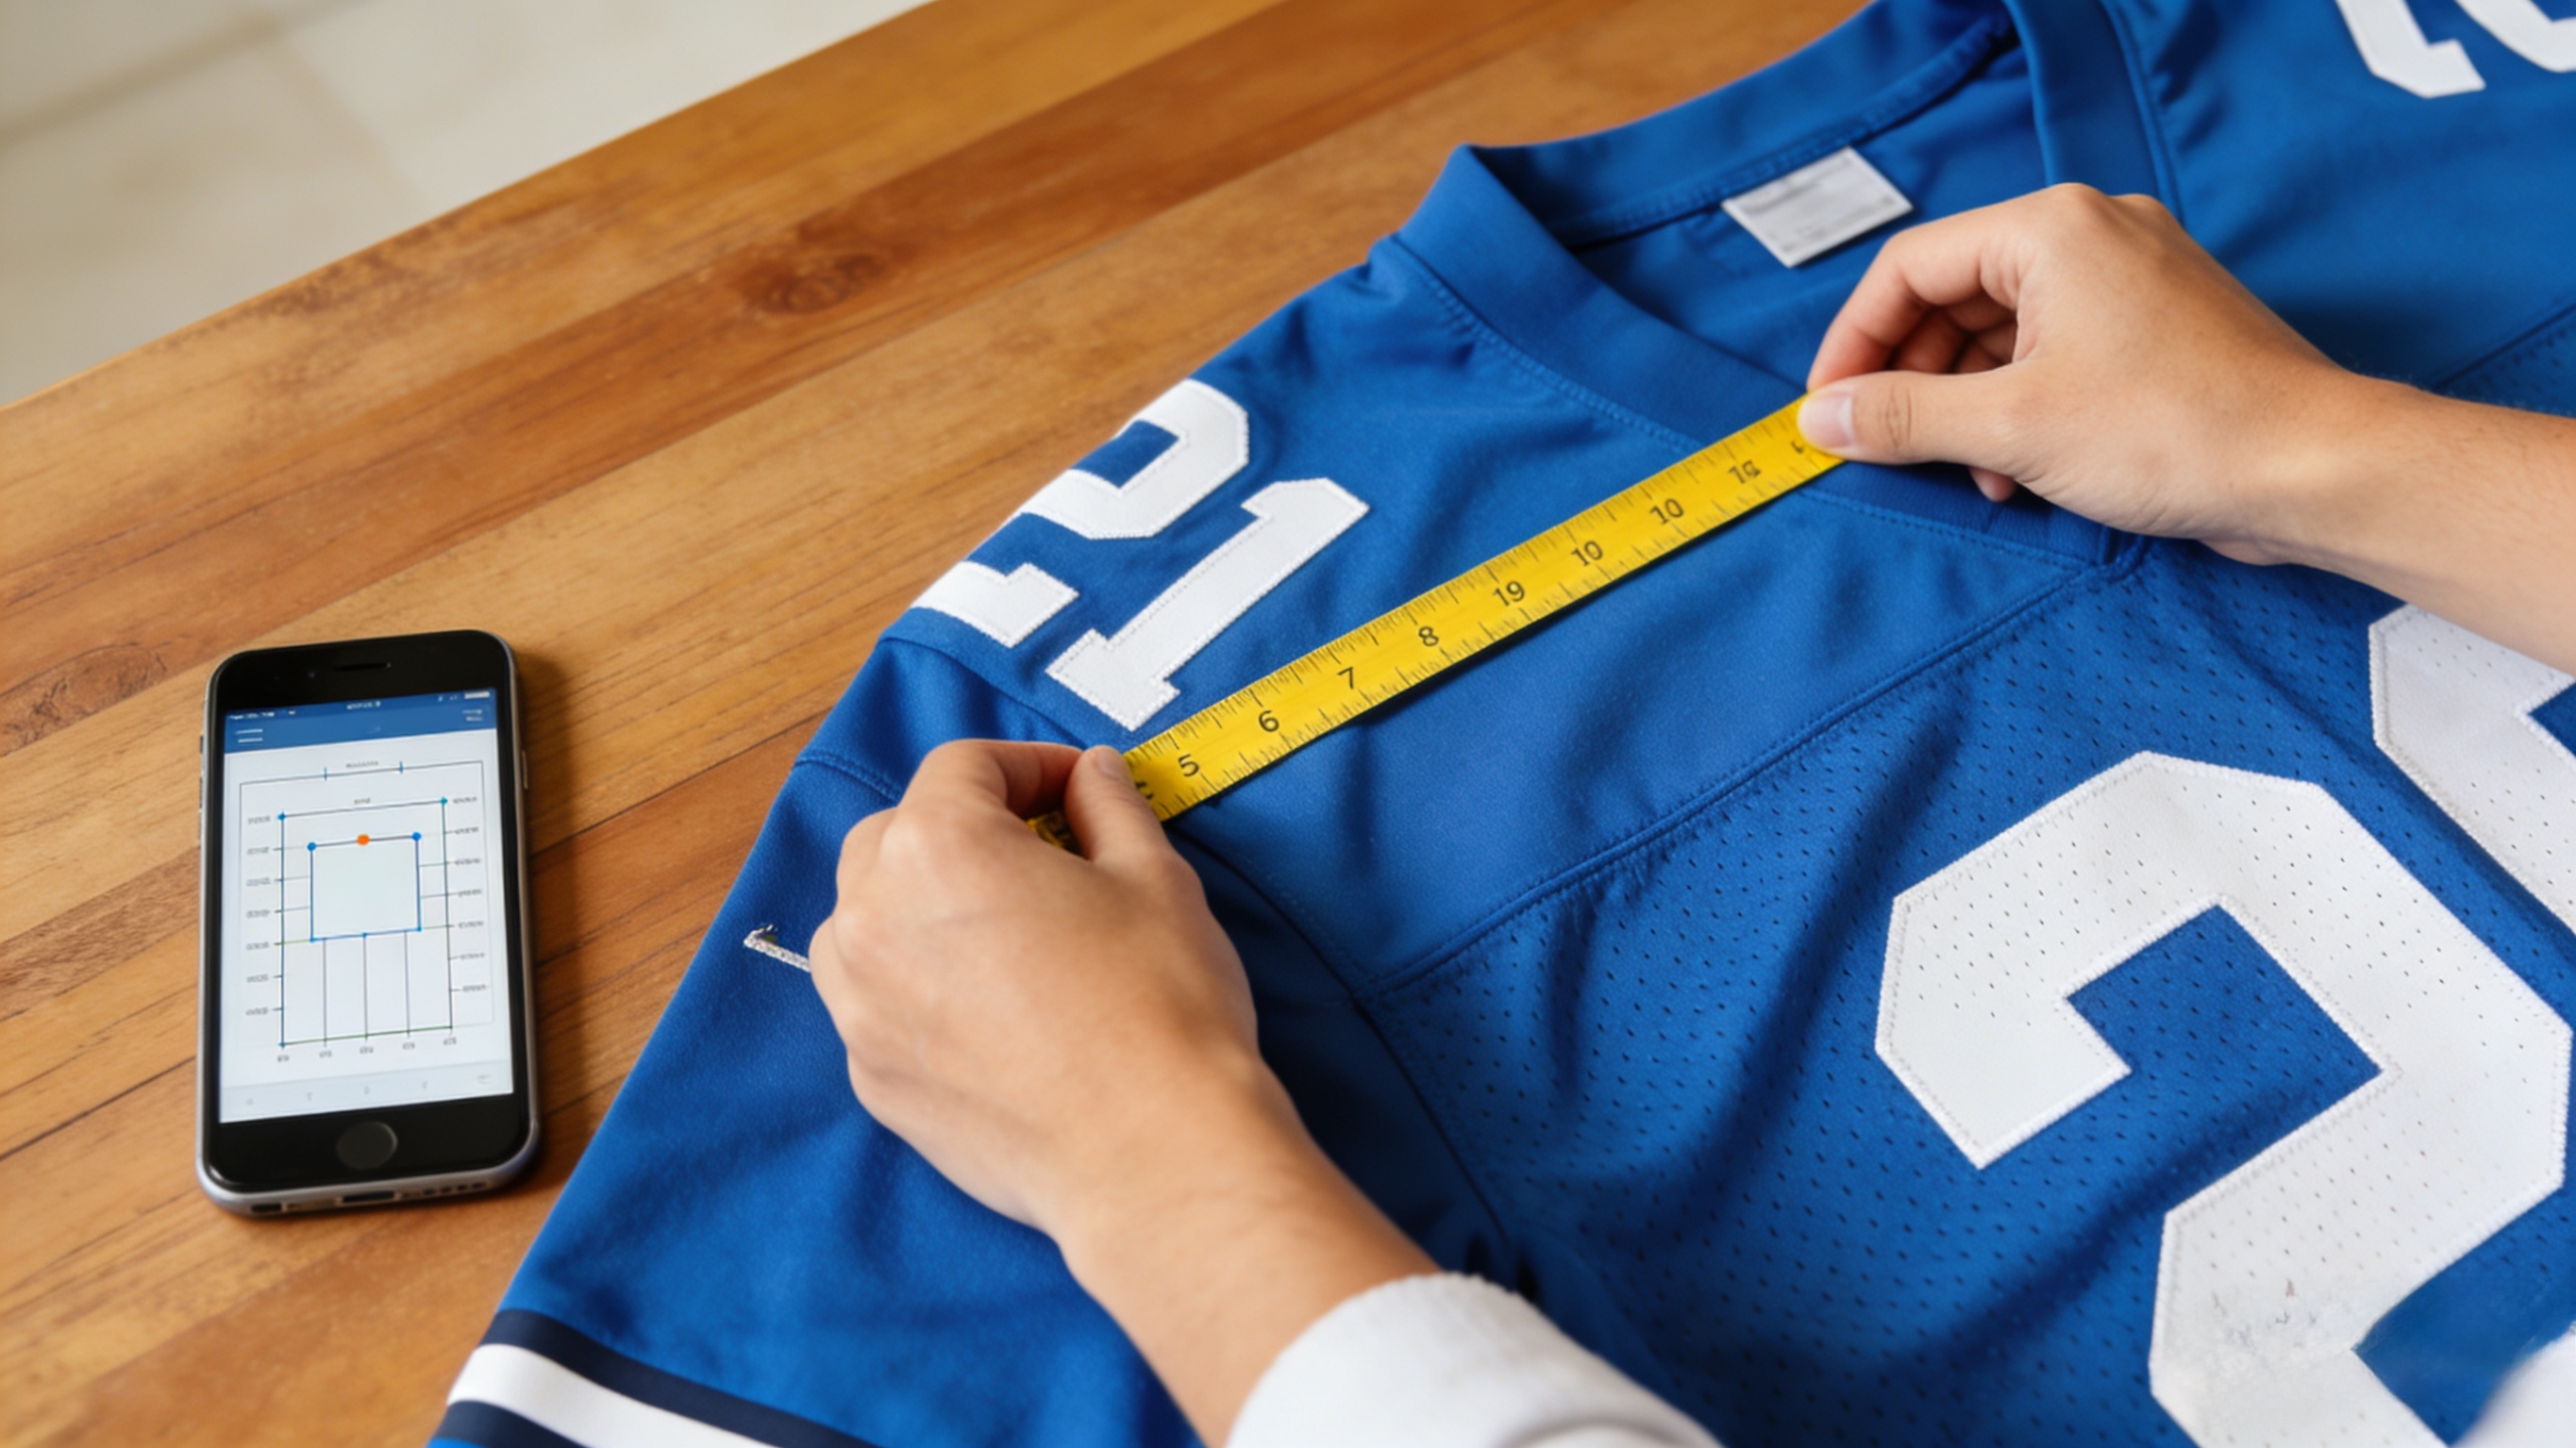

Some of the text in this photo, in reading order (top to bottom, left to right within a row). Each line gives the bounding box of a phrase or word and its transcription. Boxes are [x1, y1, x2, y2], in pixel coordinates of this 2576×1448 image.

[911, 378, 1371, 731] 21
[1178, 754, 1199, 777] 5
[1258, 710, 1280, 732] 6
[1336, 666, 1354, 690] 7
[1418, 626, 1439, 647] 8
[1493, 581, 1526, 607] 19
[1571, 541, 1603, 566] 10
[1649, 498, 1684, 525] 10
